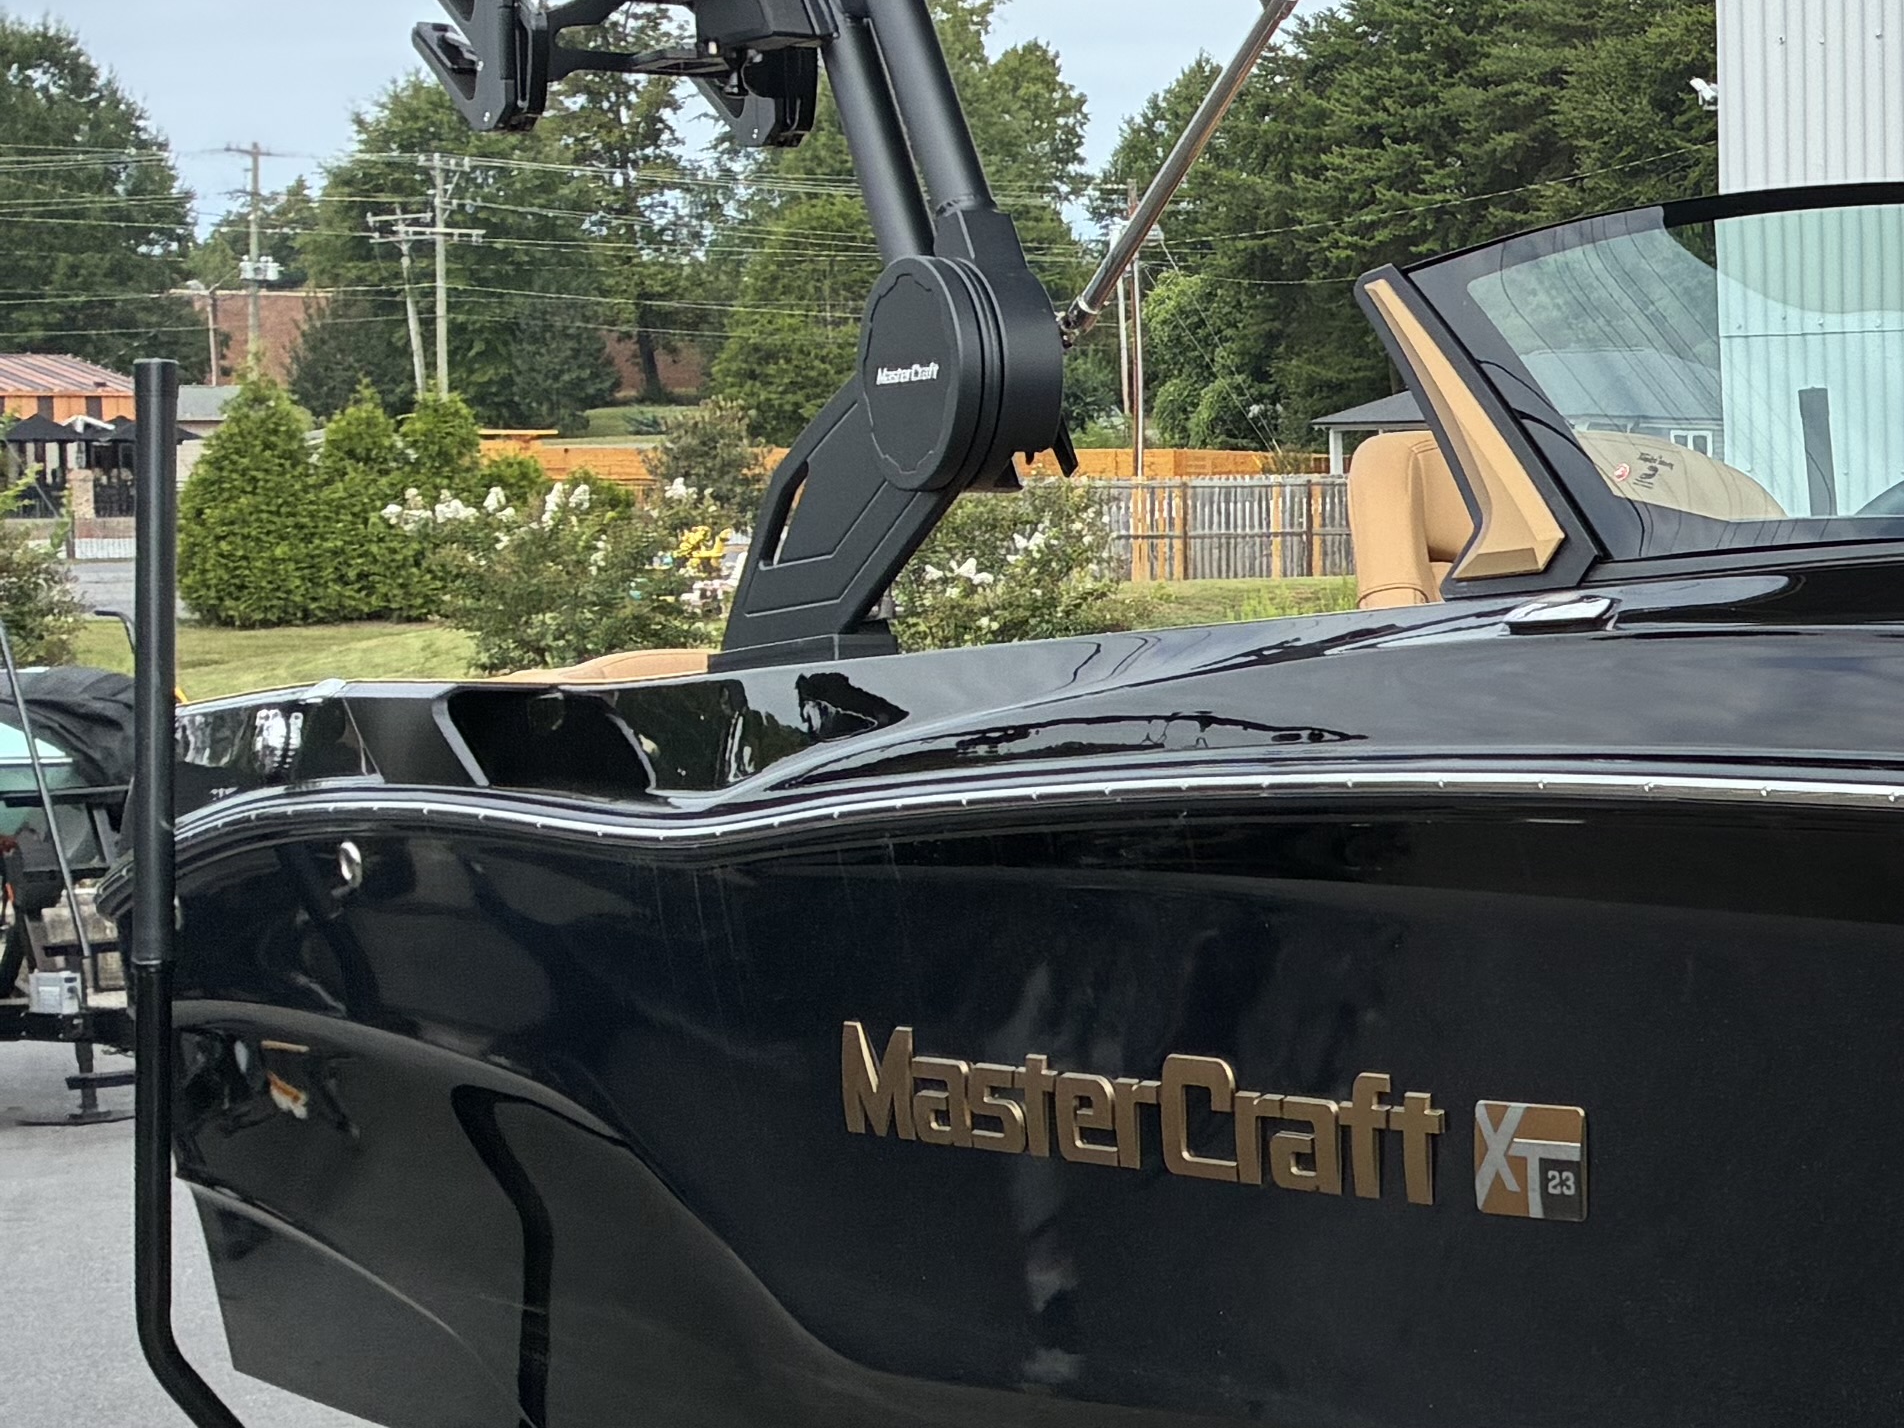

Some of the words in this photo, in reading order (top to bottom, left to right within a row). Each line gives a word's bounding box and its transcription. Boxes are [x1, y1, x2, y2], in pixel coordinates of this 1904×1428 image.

[876, 362, 939, 385] MasterCraft
[842, 1021, 1447, 1206] MasterCraft
[1547, 1170, 1576, 1195] 23
